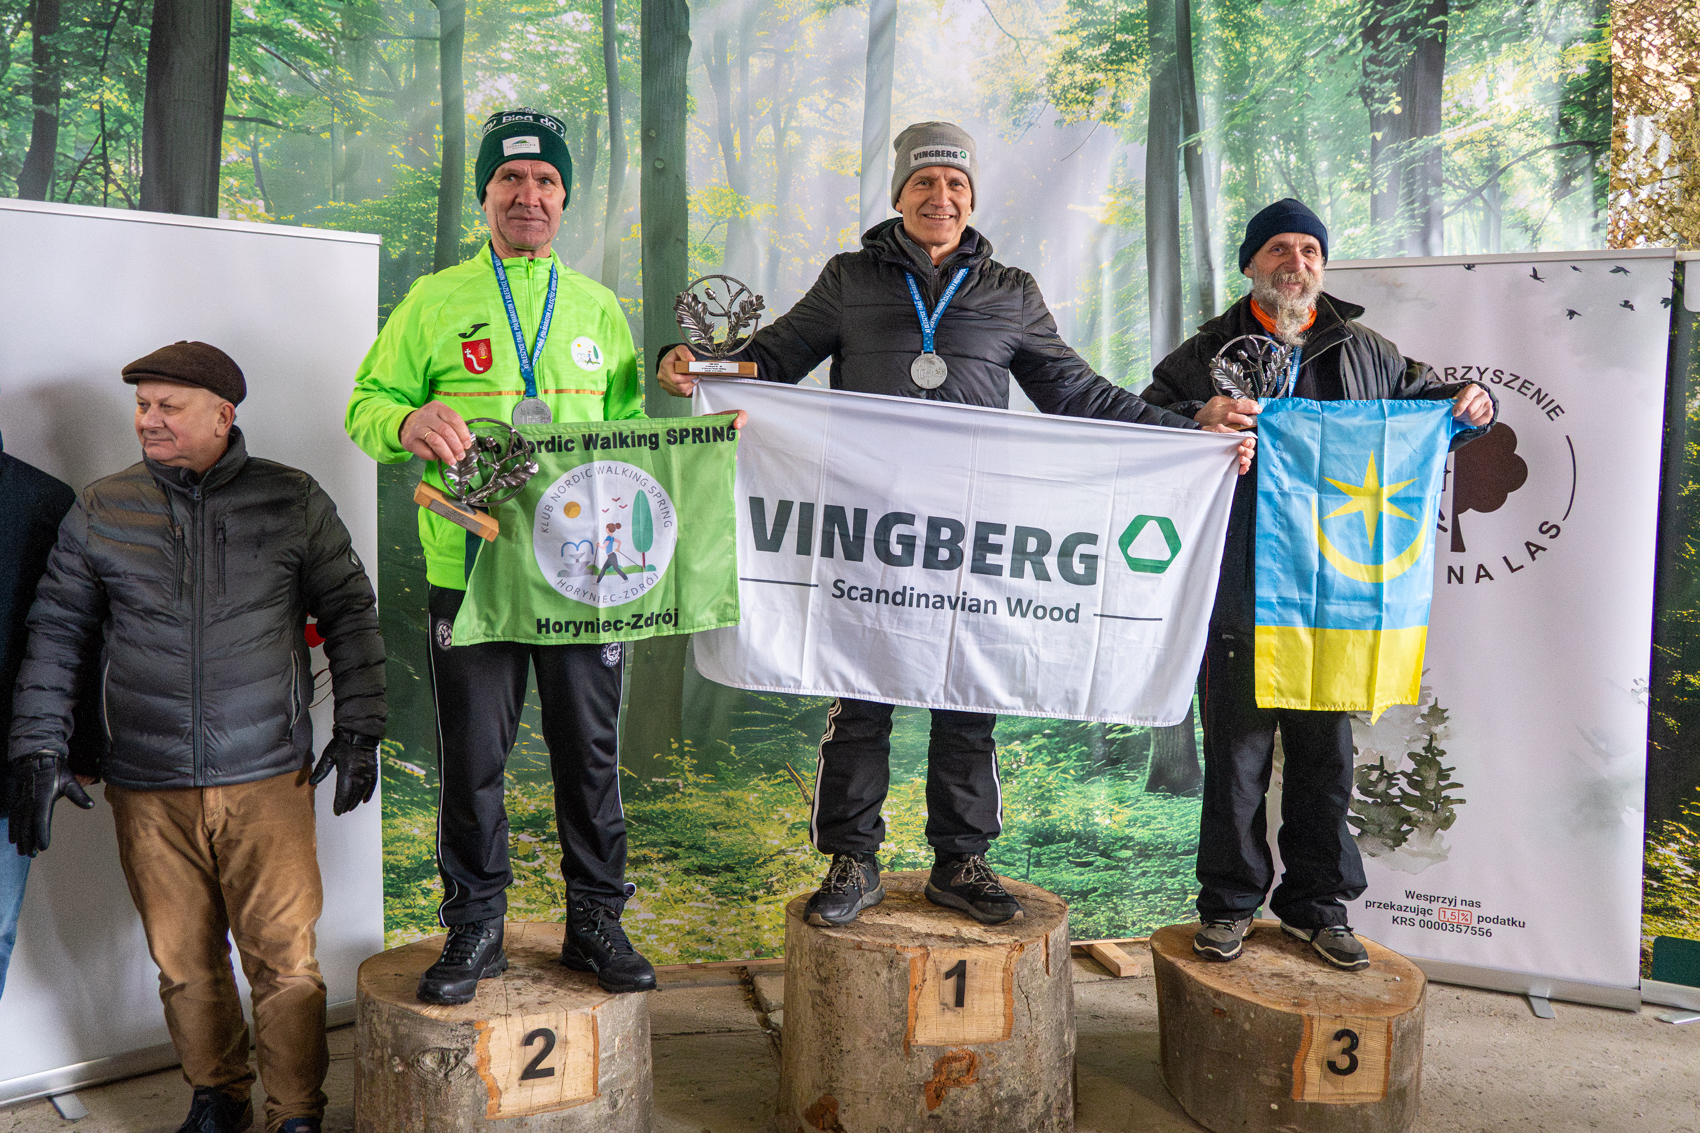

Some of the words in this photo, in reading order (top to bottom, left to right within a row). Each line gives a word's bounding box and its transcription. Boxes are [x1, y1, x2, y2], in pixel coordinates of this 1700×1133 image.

[914, 150, 958, 160] VINGBERG
[1434, 366, 1565, 422] RZYSZENIE
[582, 430, 660, 450] Walking
[666, 426, 736, 446] SPRING
[541, 504, 554, 534] KLUB
[550, 468, 594, 502] NORDIC
[595, 465, 649, 488] WALKING
[647, 485, 672, 528] SPRING
[748, 496, 1099, 586] VINGBERG
[1447, 563, 1494, 584] NA
[1502, 520, 1561, 574] LAS
[557, 572, 659, 603] HORYNIEC-ZDRÓJ
[831, 578, 998, 615] Scandinavian
[1006, 597, 1080, 623] Wood
[536, 608, 679, 637] Horyniec-Zdrój
[1365, 900, 1433, 917] przekazując
[1477, 914, 1526, 928] podatku
[1404, 890, 1457, 908] Wesprzyj
[1460, 898, 1482, 908] nas
[1392, 916, 1416, 927] KRS
[1419, 919, 1493, 937] 0000357556
[944, 960, 968, 1008] 1
[520, 1028, 556, 1080] 2
[1327, 1028, 1359, 1076] 3
